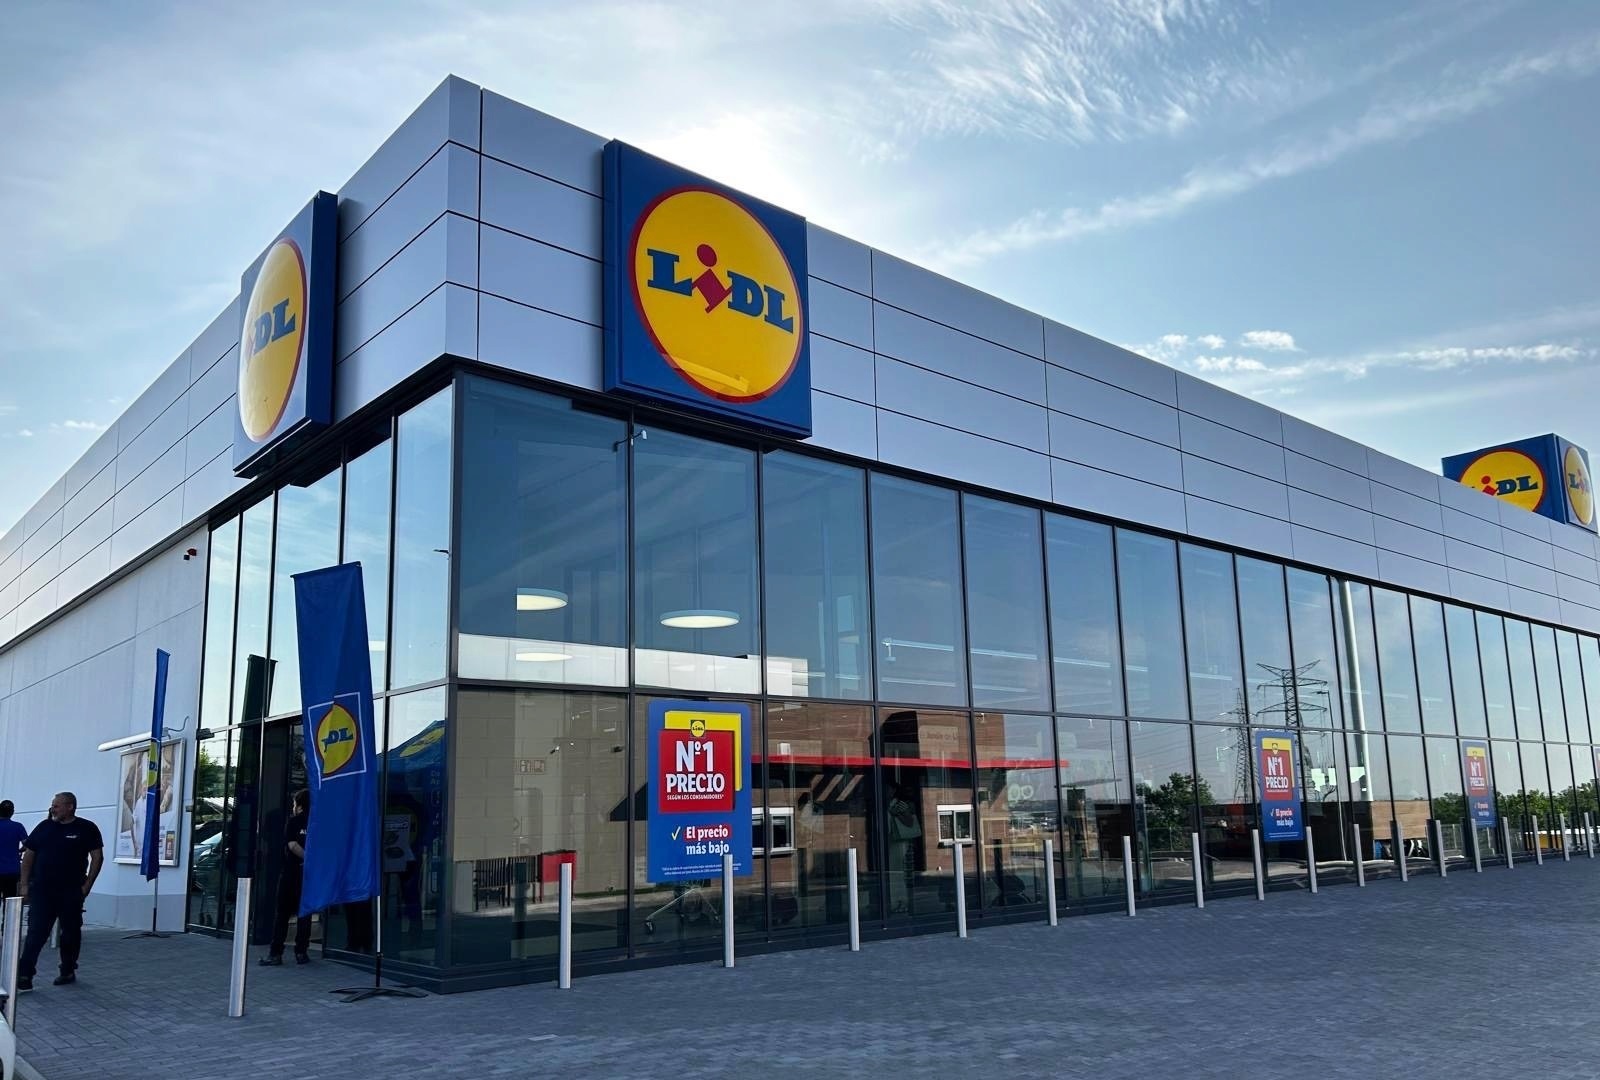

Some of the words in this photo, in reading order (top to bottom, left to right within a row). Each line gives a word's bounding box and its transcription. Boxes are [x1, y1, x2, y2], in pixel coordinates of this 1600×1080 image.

[1471, 475, 1538, 496] iDL
[665, 773, 725, 793] PRECIO
[686, 825, 696, 839] El
[697, 824, 729, 841] precio
[686, 841, 707, 855] más
[708, 840, 730, 856] bajo
